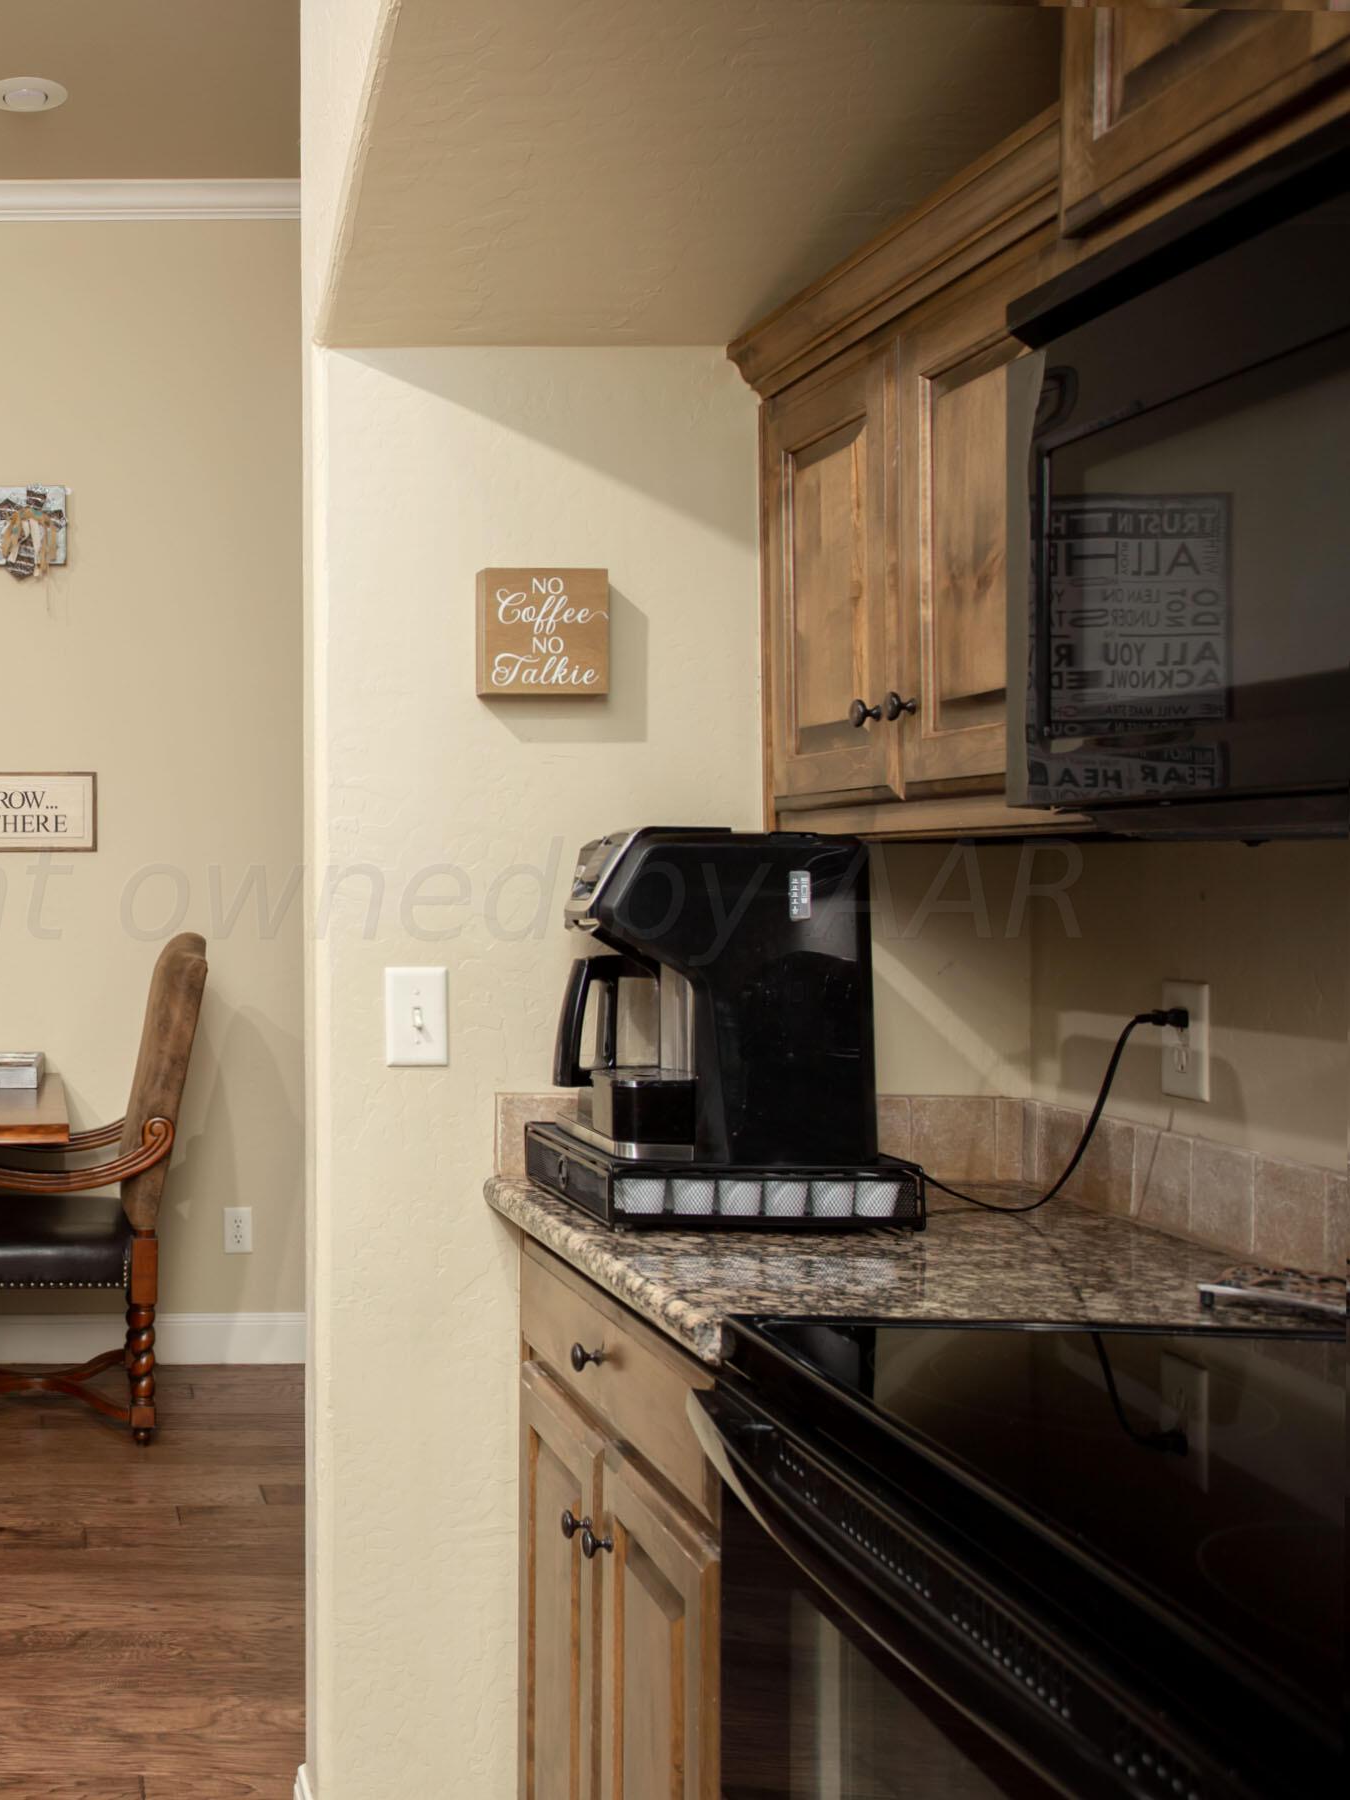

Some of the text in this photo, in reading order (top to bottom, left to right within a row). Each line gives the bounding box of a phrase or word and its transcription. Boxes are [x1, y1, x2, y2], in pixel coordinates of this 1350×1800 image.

[532, 577, 564, 594] NO
[496, 588, 609, 635] Coffee
[532, 637, 564, 654] NO
[492, 653, 600, 687] Talkie
